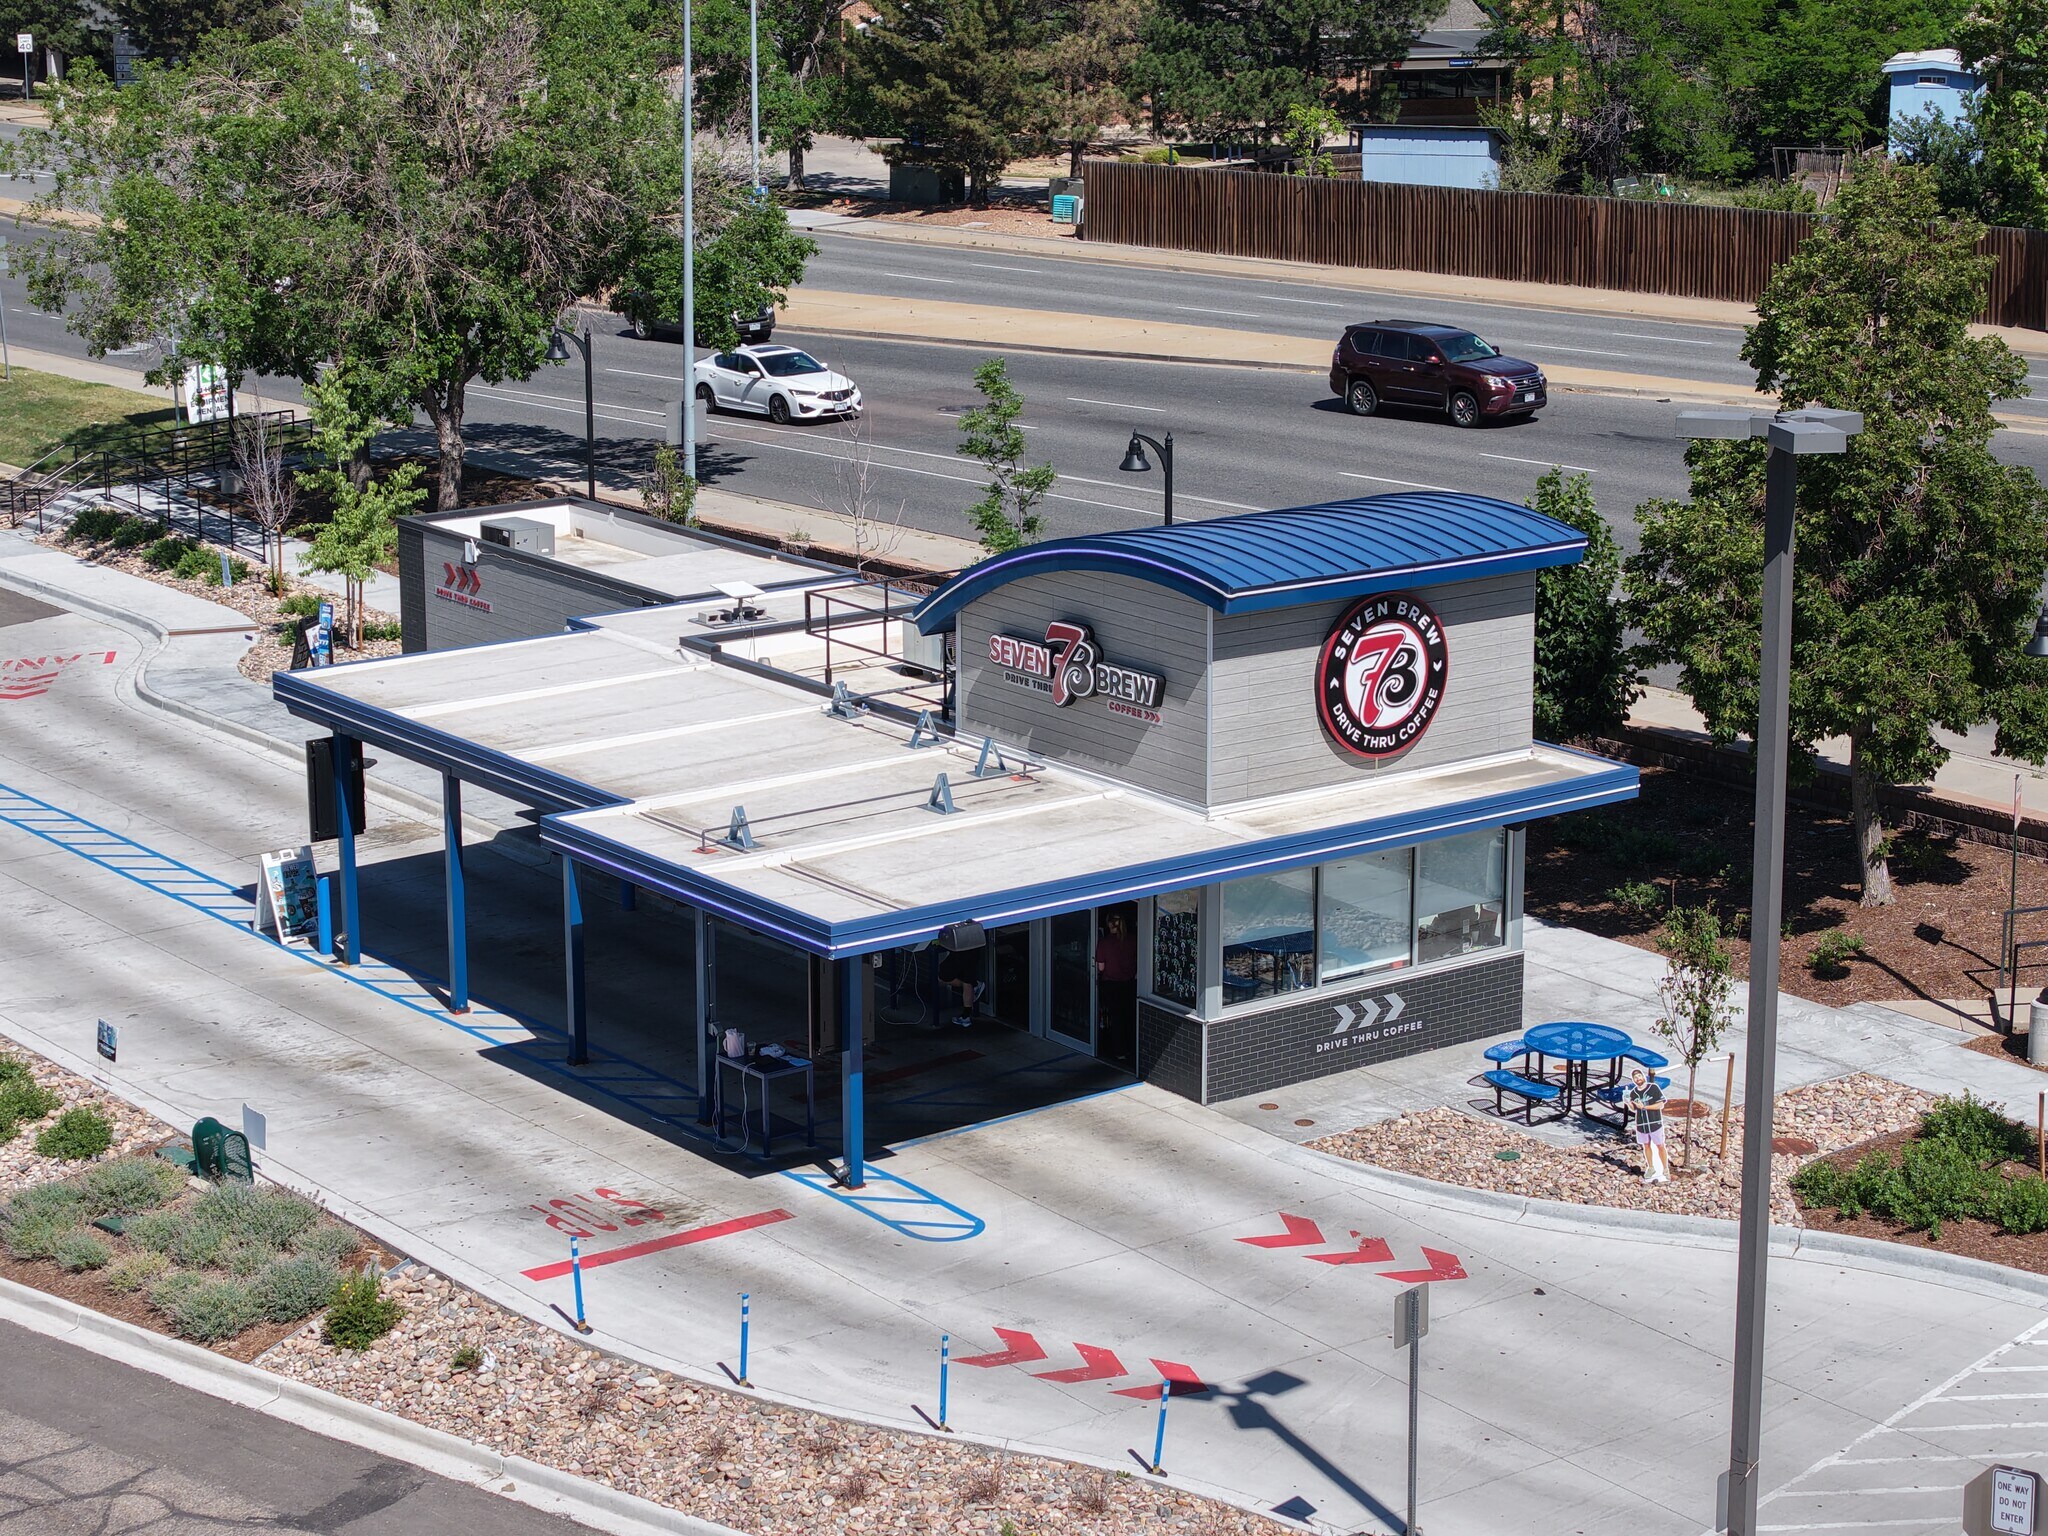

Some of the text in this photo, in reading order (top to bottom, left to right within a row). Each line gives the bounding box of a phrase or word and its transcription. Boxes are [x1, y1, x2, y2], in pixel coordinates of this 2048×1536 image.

[469, 598, 491, 611] COFFEE
[1334, 600, 1441, 660] SEVEN BREW
[989, 634, 1051, 677] SEVEN
[1096, 662, 1157, 706] BREW
[1005, 671, 1030, 687] DRIVE
[1108, 701, 1143, 719] COFFEE
[1332, 687, 1439, 749] DRIVE THRU COFFEE
[1316, 1020, 1423, 1053] DRIVE THRU COFFEE
[1997, 1481, 2030, 1495] ONE WAY
[1999, 1496, 2027, 1510] DO NOT
[2000, 1511, 2024, 1524] ENTER
